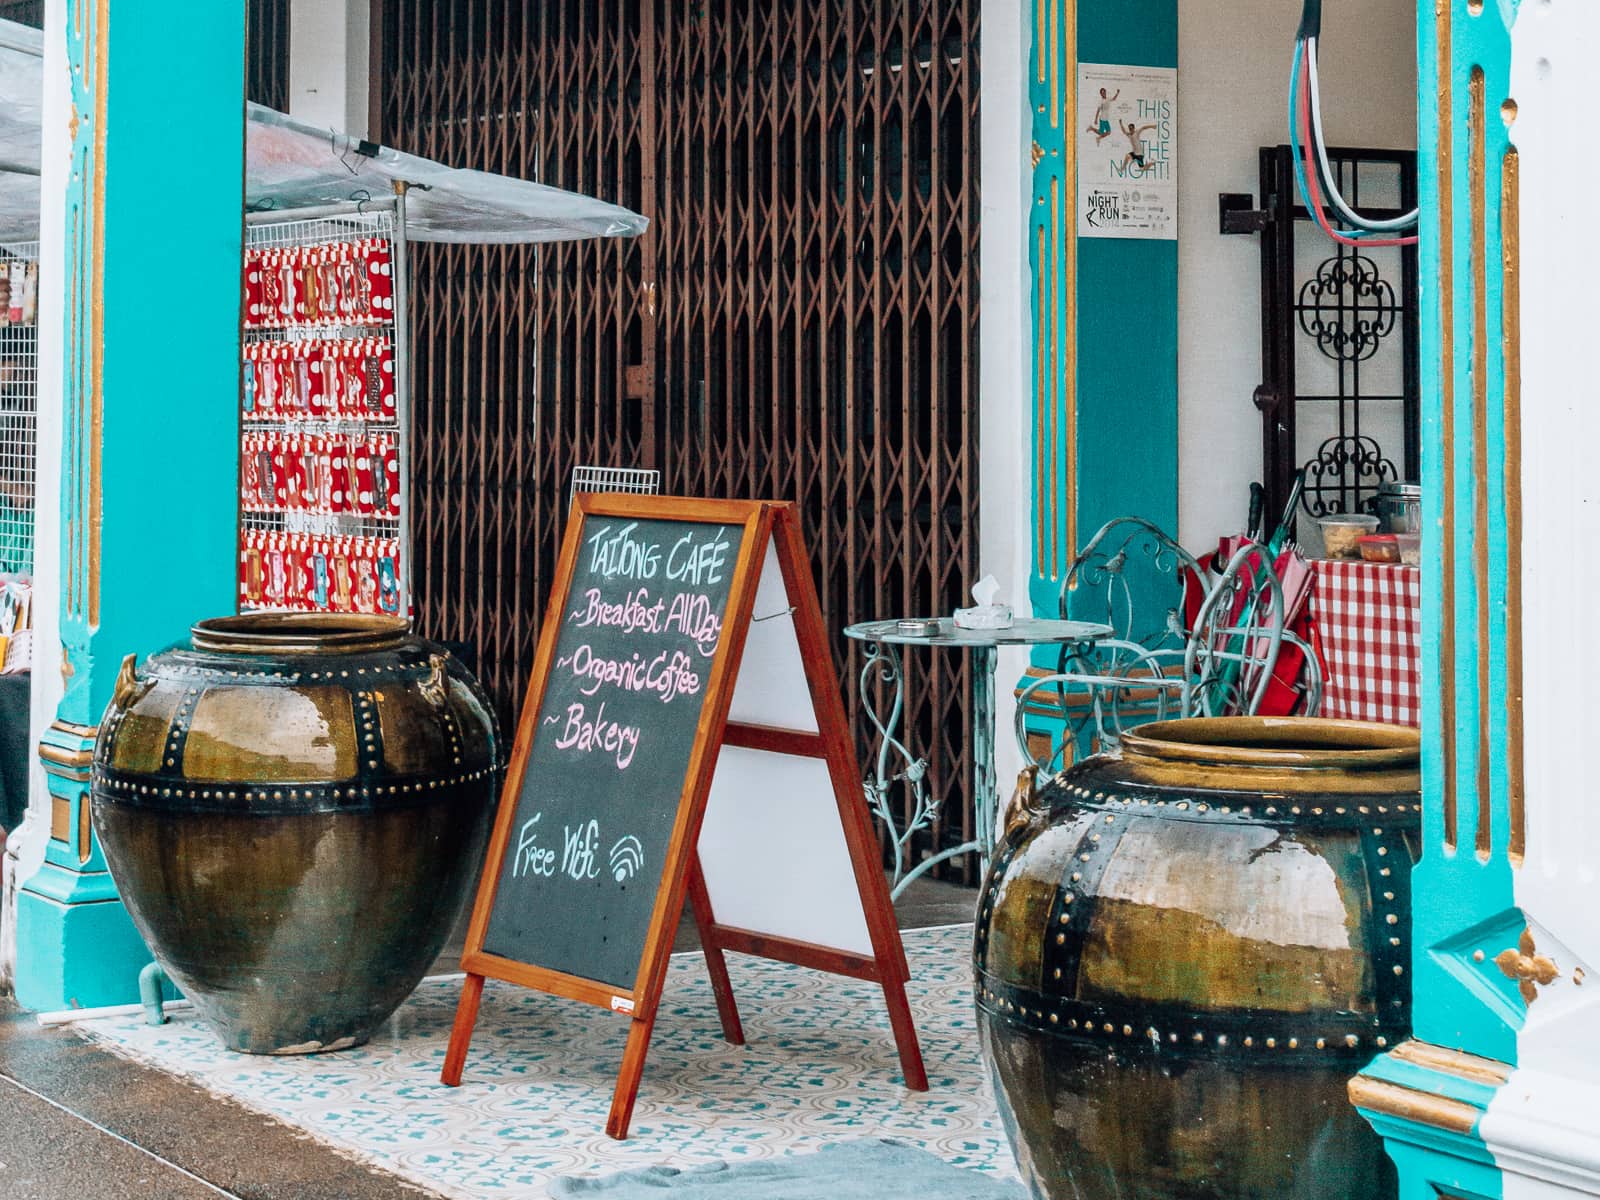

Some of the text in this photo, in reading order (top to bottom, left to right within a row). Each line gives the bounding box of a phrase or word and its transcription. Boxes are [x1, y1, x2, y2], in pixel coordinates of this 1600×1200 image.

[1136, 99, 1170, 120] THIS
[1157, 120, 1170, 140] IS
[1139, 140, 1169, 160] THE
[1110, 159, 1169, 180] NIGHT!
[1088, 195, 1119, 208] NIGHT
[1100, 208, 1120, 220] RUN
[588, 522, 730, 585] TAITONG CAFÉ
[576, 587, 665, 634] Breakfast
[573, 644, 701, 702] Organic Coffee
[555, 701, 640, 770] Bakery
[512, 812, 600, 880] Free Wifi
